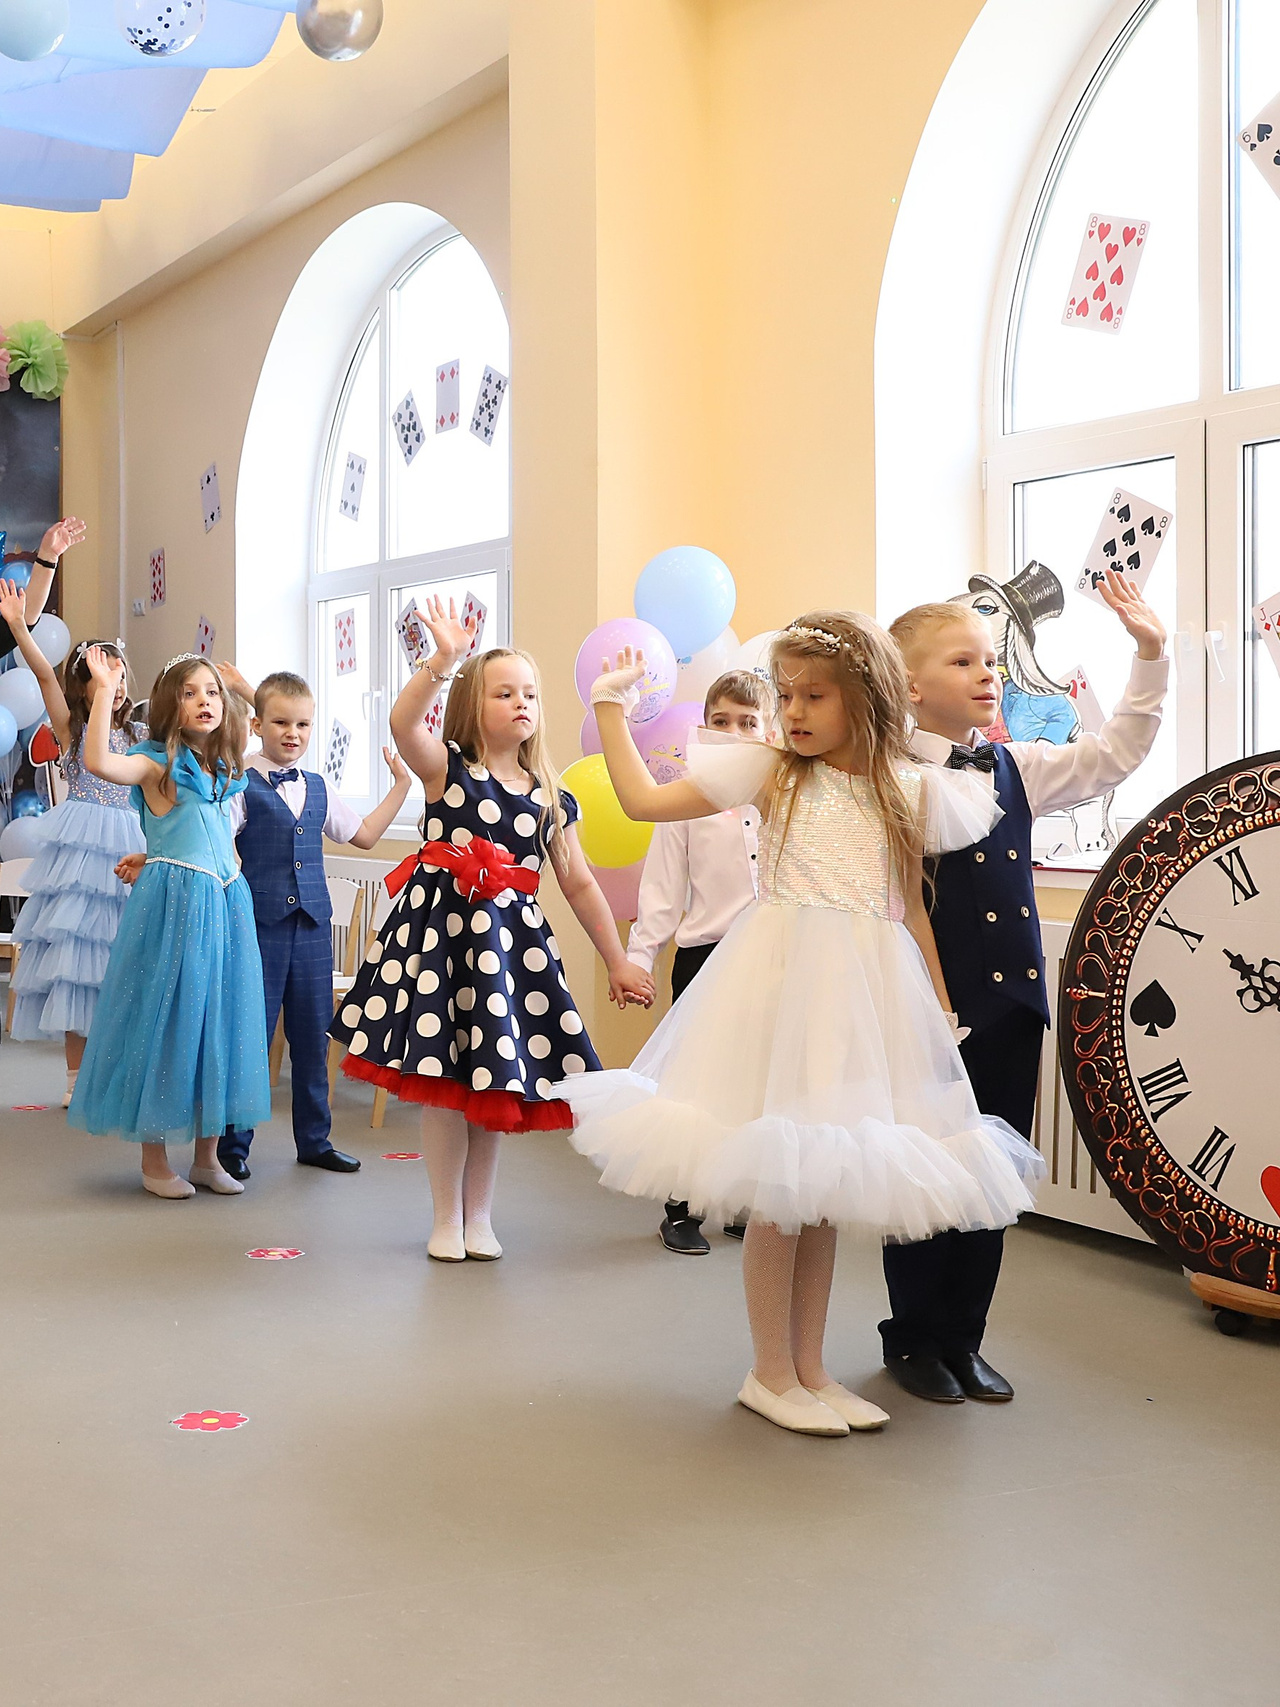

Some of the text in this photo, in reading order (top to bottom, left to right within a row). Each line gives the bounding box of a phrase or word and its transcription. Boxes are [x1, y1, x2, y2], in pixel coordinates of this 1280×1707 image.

[1090, 216, 1098, 228] 8
[1138, 223, 1146, 236] 8
[1066, 307, 1074, 319] 8
[1113, 317, 1120, 330] 8
[1113, 492, 1122, 504] 8
[1160, 516, 1168, 528] 8
[1078, 578, 1087, 590] 8
[1260, 607, 1267, 621] J
[1213, 845, 1261, 906] XI
[1154, 907, 1205, 954] X
[1136, 1057, 1193, 1124] VIII
[1187, 1125, 1237, 1193] VII
